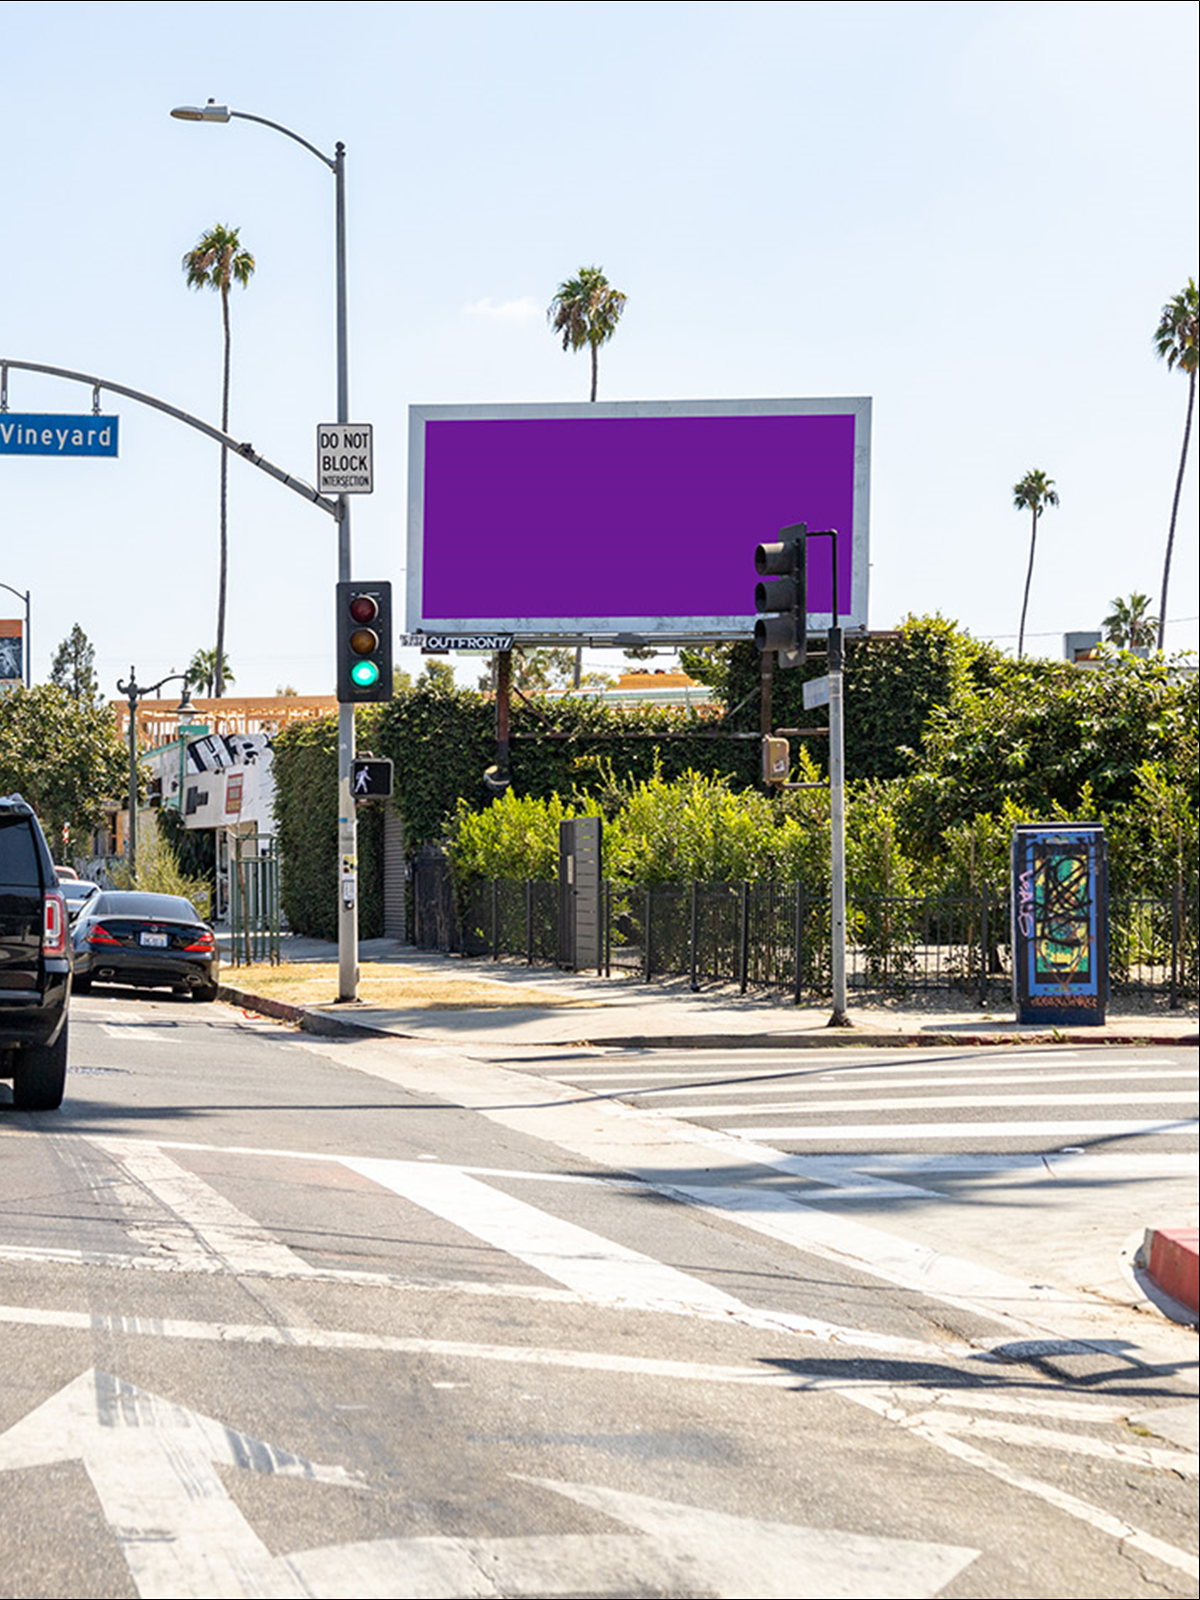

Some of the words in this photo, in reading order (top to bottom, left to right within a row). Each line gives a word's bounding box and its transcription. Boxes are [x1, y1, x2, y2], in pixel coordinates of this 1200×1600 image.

[0, 422, 111, 451] Vineyard
[320, 432, 340, 449] DO
[343, 432, 369, 449] NOT
[322, 455, 368, 471] BLOCK
[322, 475, 370, 487] INTERSECTION
